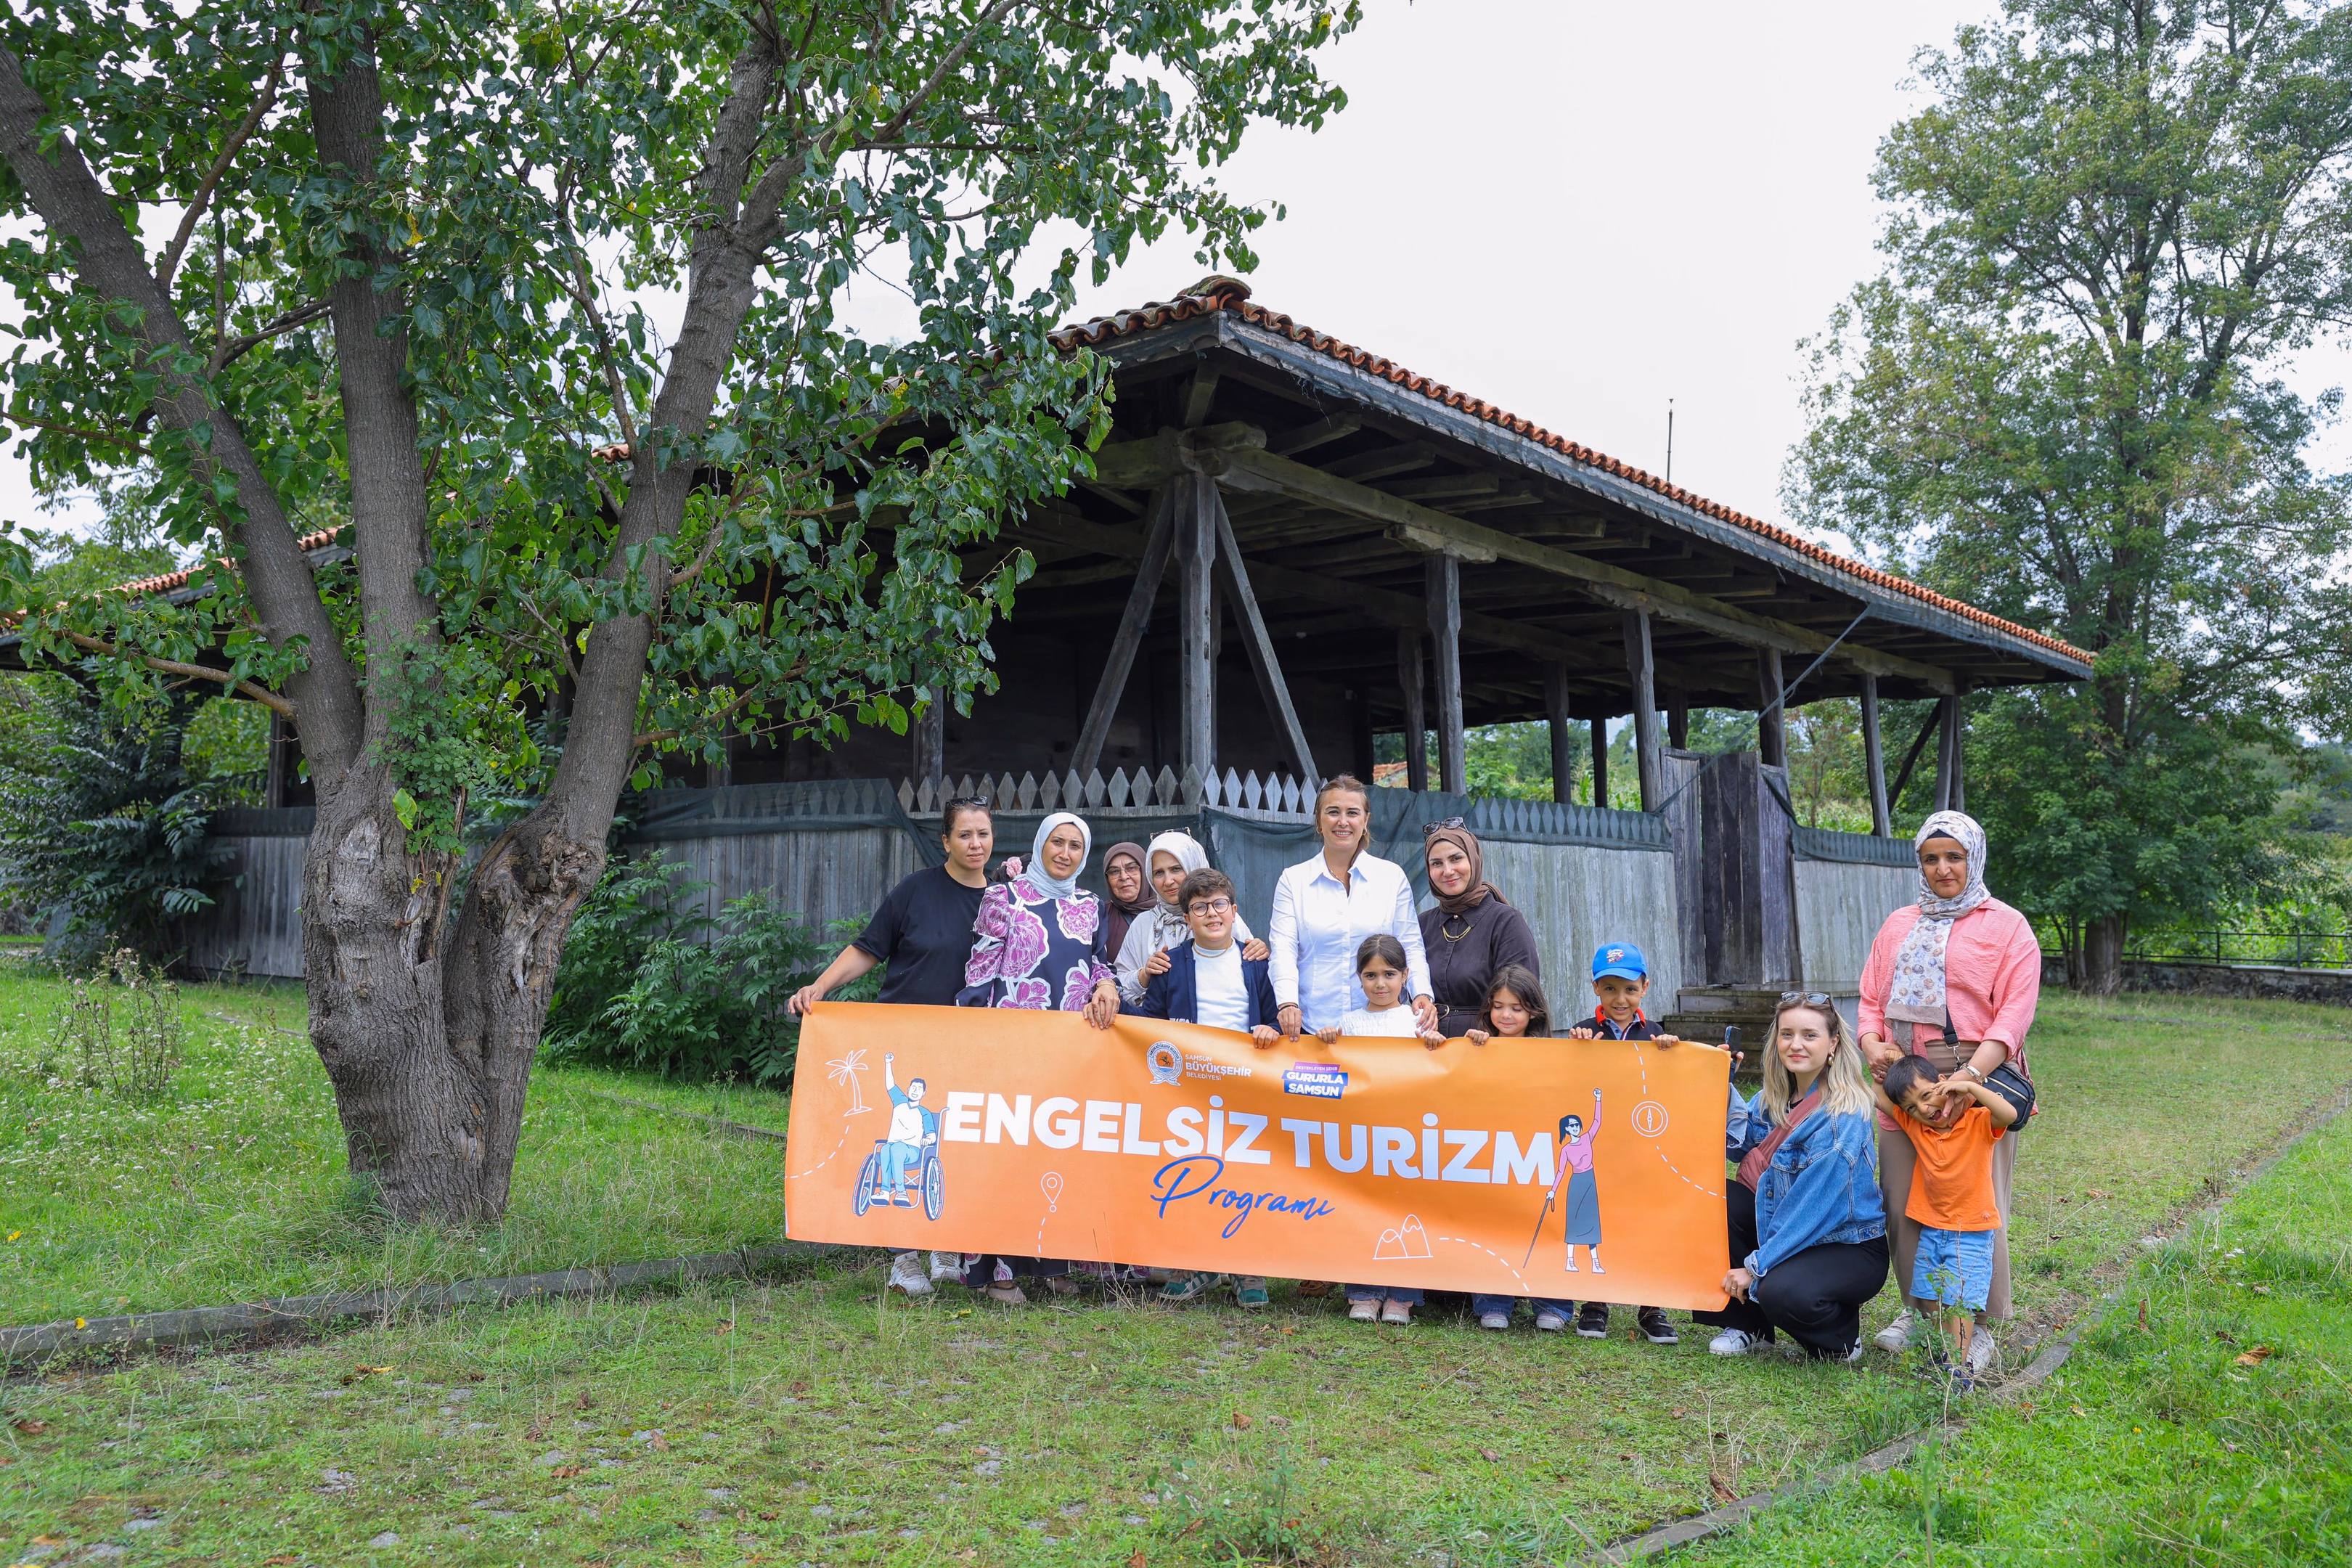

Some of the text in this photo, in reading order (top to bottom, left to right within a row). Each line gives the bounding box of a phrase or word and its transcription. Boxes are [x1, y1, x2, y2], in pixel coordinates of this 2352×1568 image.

[1185, 1061, 1251, 1077] BÜYÜKŞEHİR
[1186, 1071, 1222, 1081] BELEDİYESİ
[1286, 1071, 1344, 1085] GURURLA
[1288, 1082, 1339, 1097] SAMSUN
[943, 1091, 1556, 1186] ENGELSİZ TURİZM
[1150, 1156, 1336, 1239] Programı
